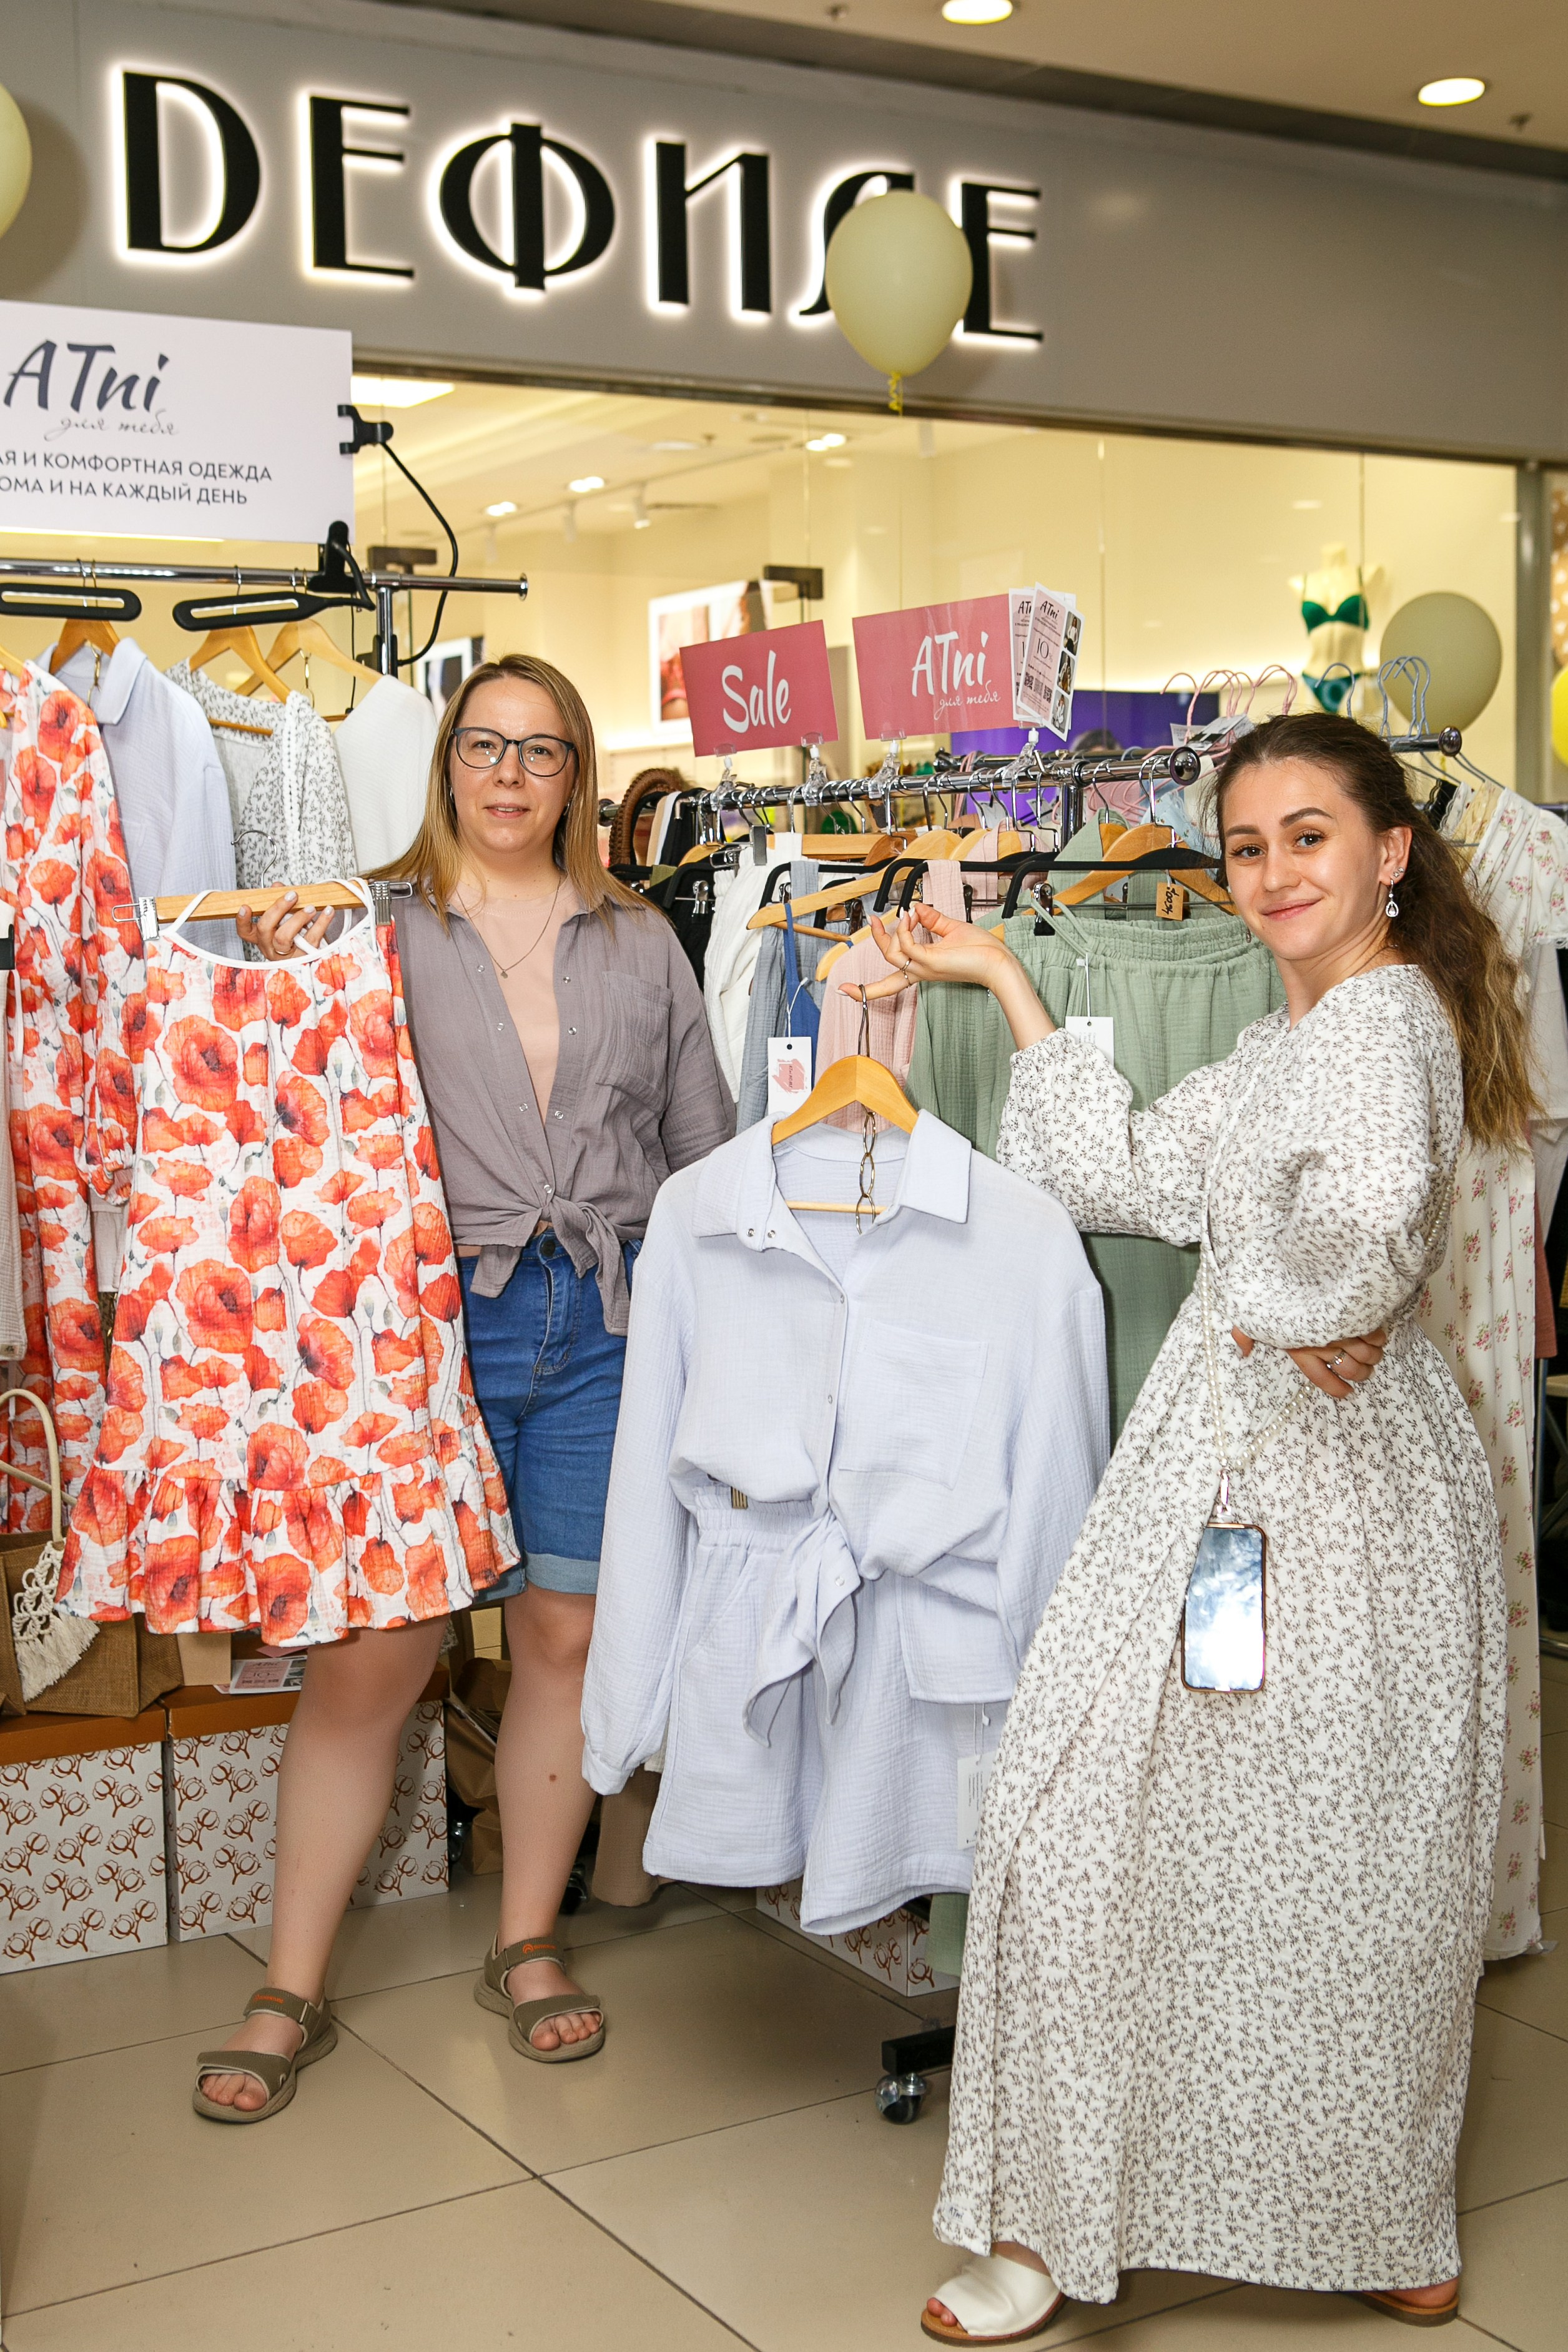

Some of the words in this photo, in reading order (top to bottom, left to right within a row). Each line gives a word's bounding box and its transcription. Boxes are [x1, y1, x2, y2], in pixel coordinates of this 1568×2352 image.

[0, 450, 16, 466] Я
[24, 450, 36, 467] И
[44, 452, 183, 475] КОМФОРТНАЯ
[189, 461, 272, 483] ОДЕЖДА
[50, 478, 63, 495] И
[70, 480, 97, 497] НА
[102, 482, 191, 503] КАЖДЫЙ
[196, 487, 247, 506] ДЕНЬ
[721, 650, 792, 734] Sale
[934, 695, 963, 721] для
[966, 679, 1001, 704] тебя
